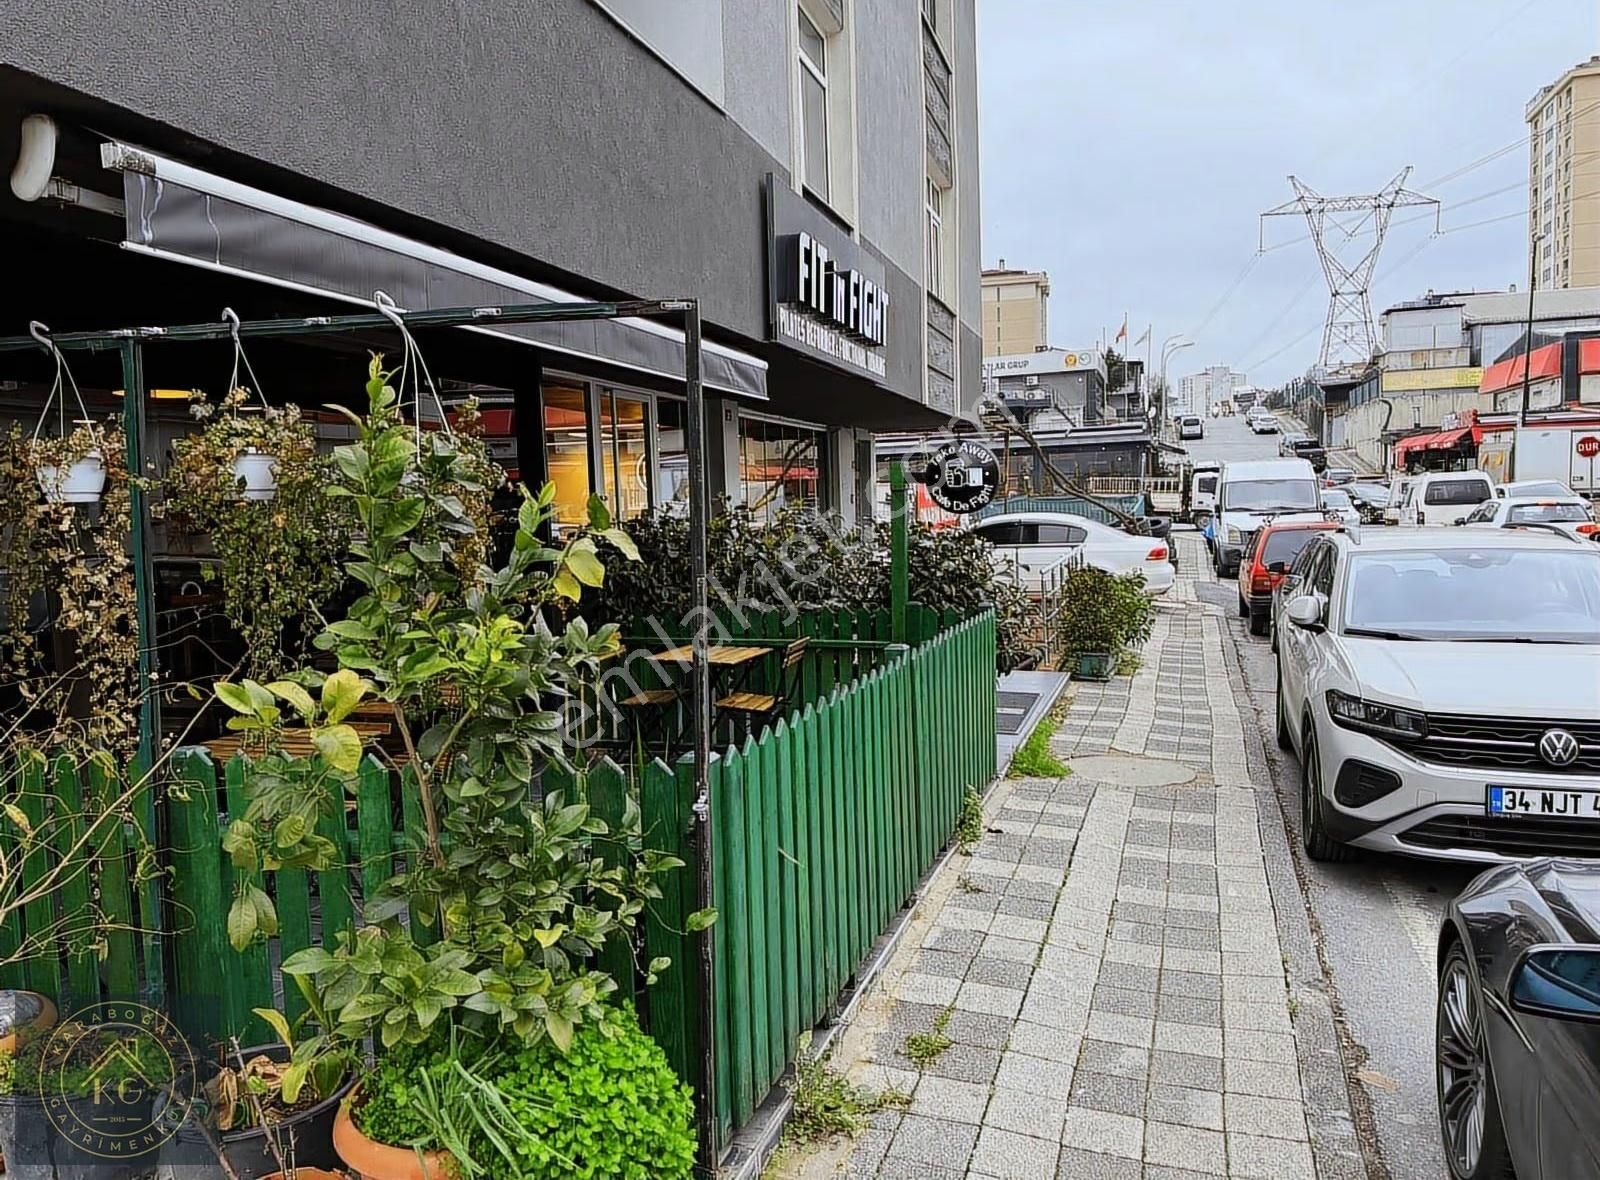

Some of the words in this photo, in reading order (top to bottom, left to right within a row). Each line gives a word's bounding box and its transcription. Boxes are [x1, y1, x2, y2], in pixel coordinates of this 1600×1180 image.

[799, 231, 828, 313] FIT
[849, 269, 889, 346] FIGHT
[958, 442, 993, 464] Away
[1577, 442, 1599, 452] DUR
[953, 500, 969, 511] De
[969, 484, 994, 508] Fight
[1504, 790, 1531, 812] 34
[1541, 792, 1582, 815] NJT
